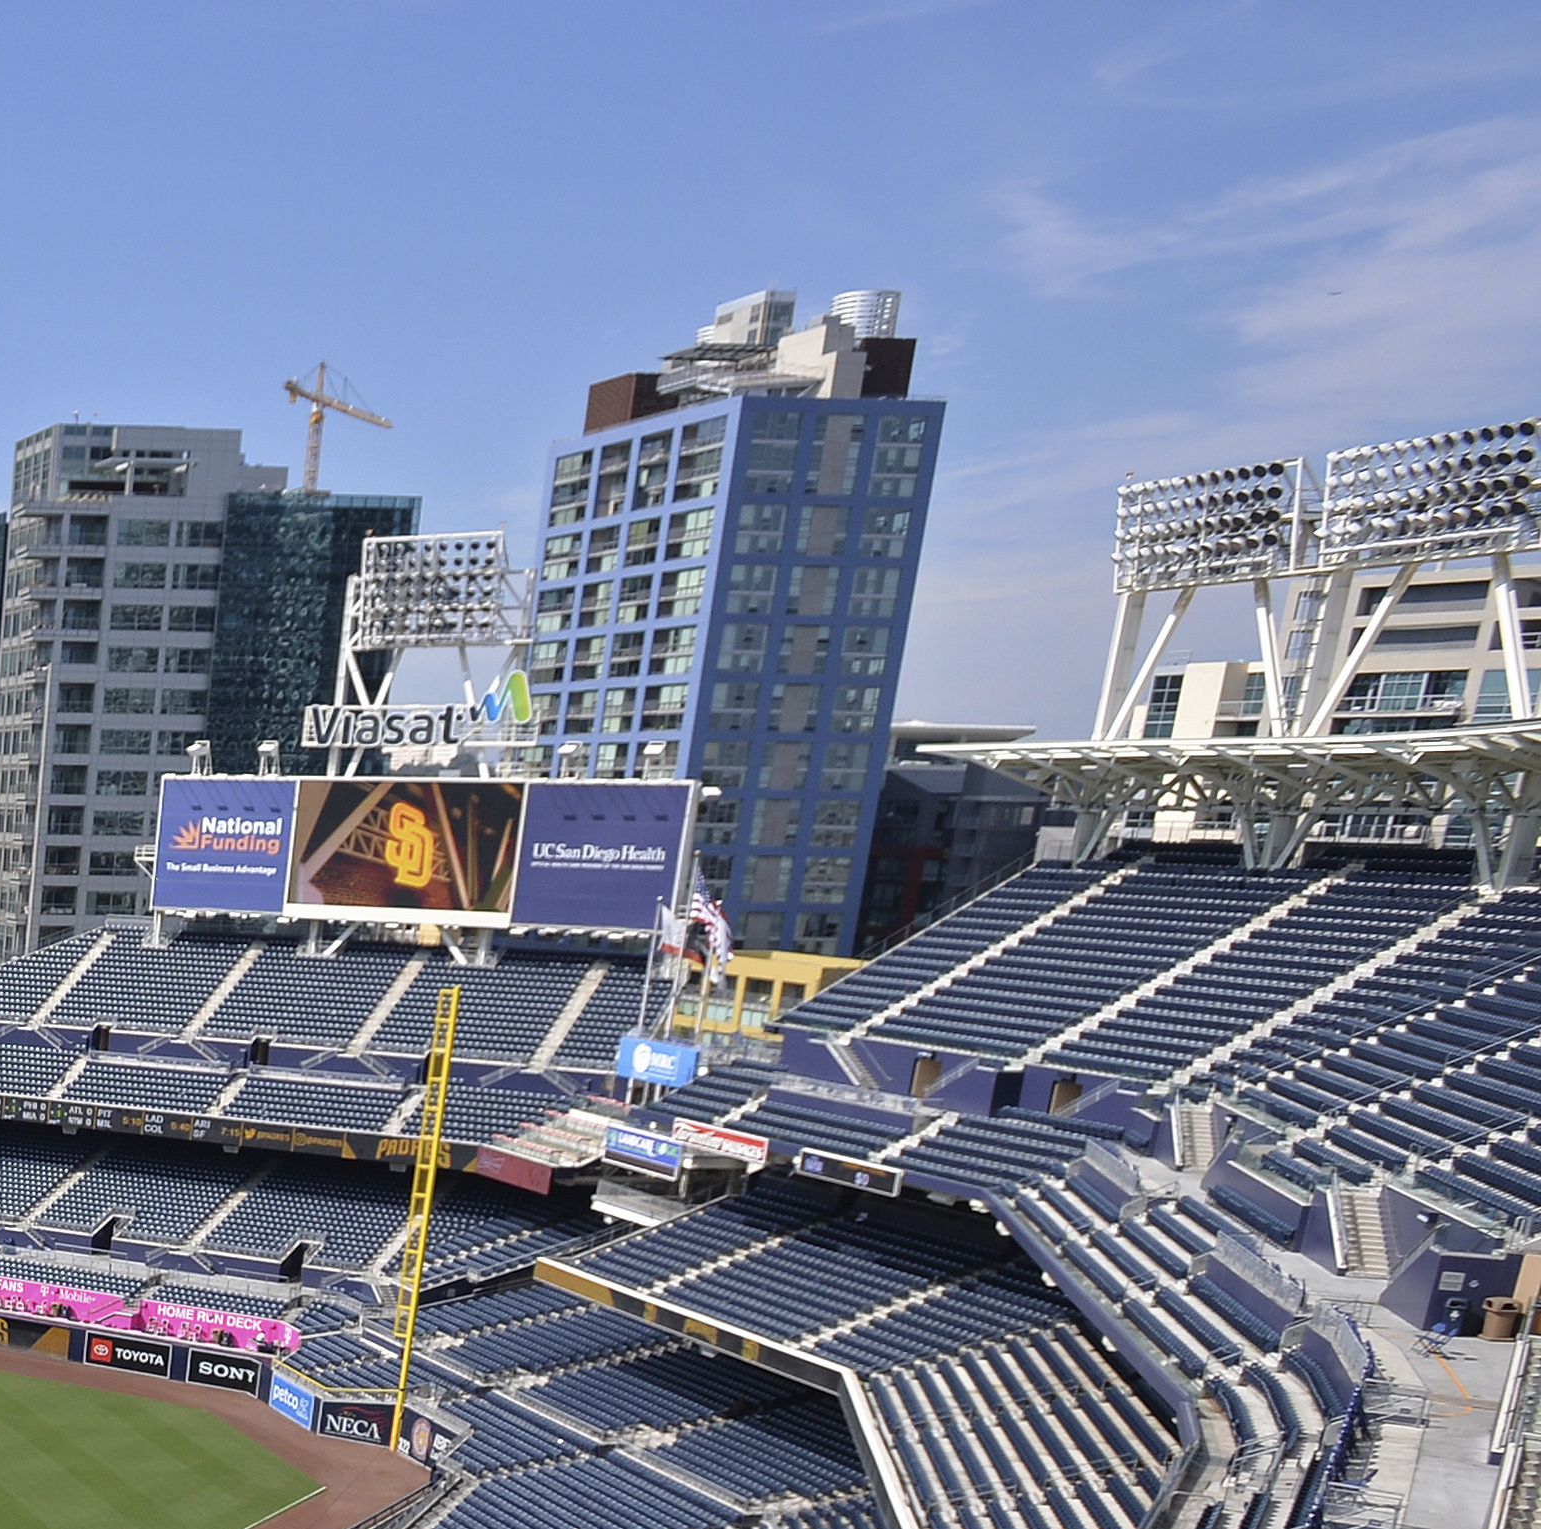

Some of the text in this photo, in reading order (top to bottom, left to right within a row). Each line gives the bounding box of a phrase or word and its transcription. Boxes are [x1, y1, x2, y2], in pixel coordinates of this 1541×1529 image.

[311, 705, 459, 745] Viasat
[201, 816, 283, 835] National
[200, 834, 281, 855] Funding
[533, 843, 665, 862] UC San Diego Health
[166, 862, 277, 876] The Small Business Advantage
[144, 1124, 163, 1134] COL
[145, 1114, 164, 1124] LAD
[157, 1304, 193, 1321] HOME
[226, 1317, 262, 1331] DECK
[115, 1347, 165, 1367] TOYOTA
[198, 1362, 256, 1383] SONY
[273, 1385, 299, 1410] petco
[325, 1414, 381, 1440] NECA
